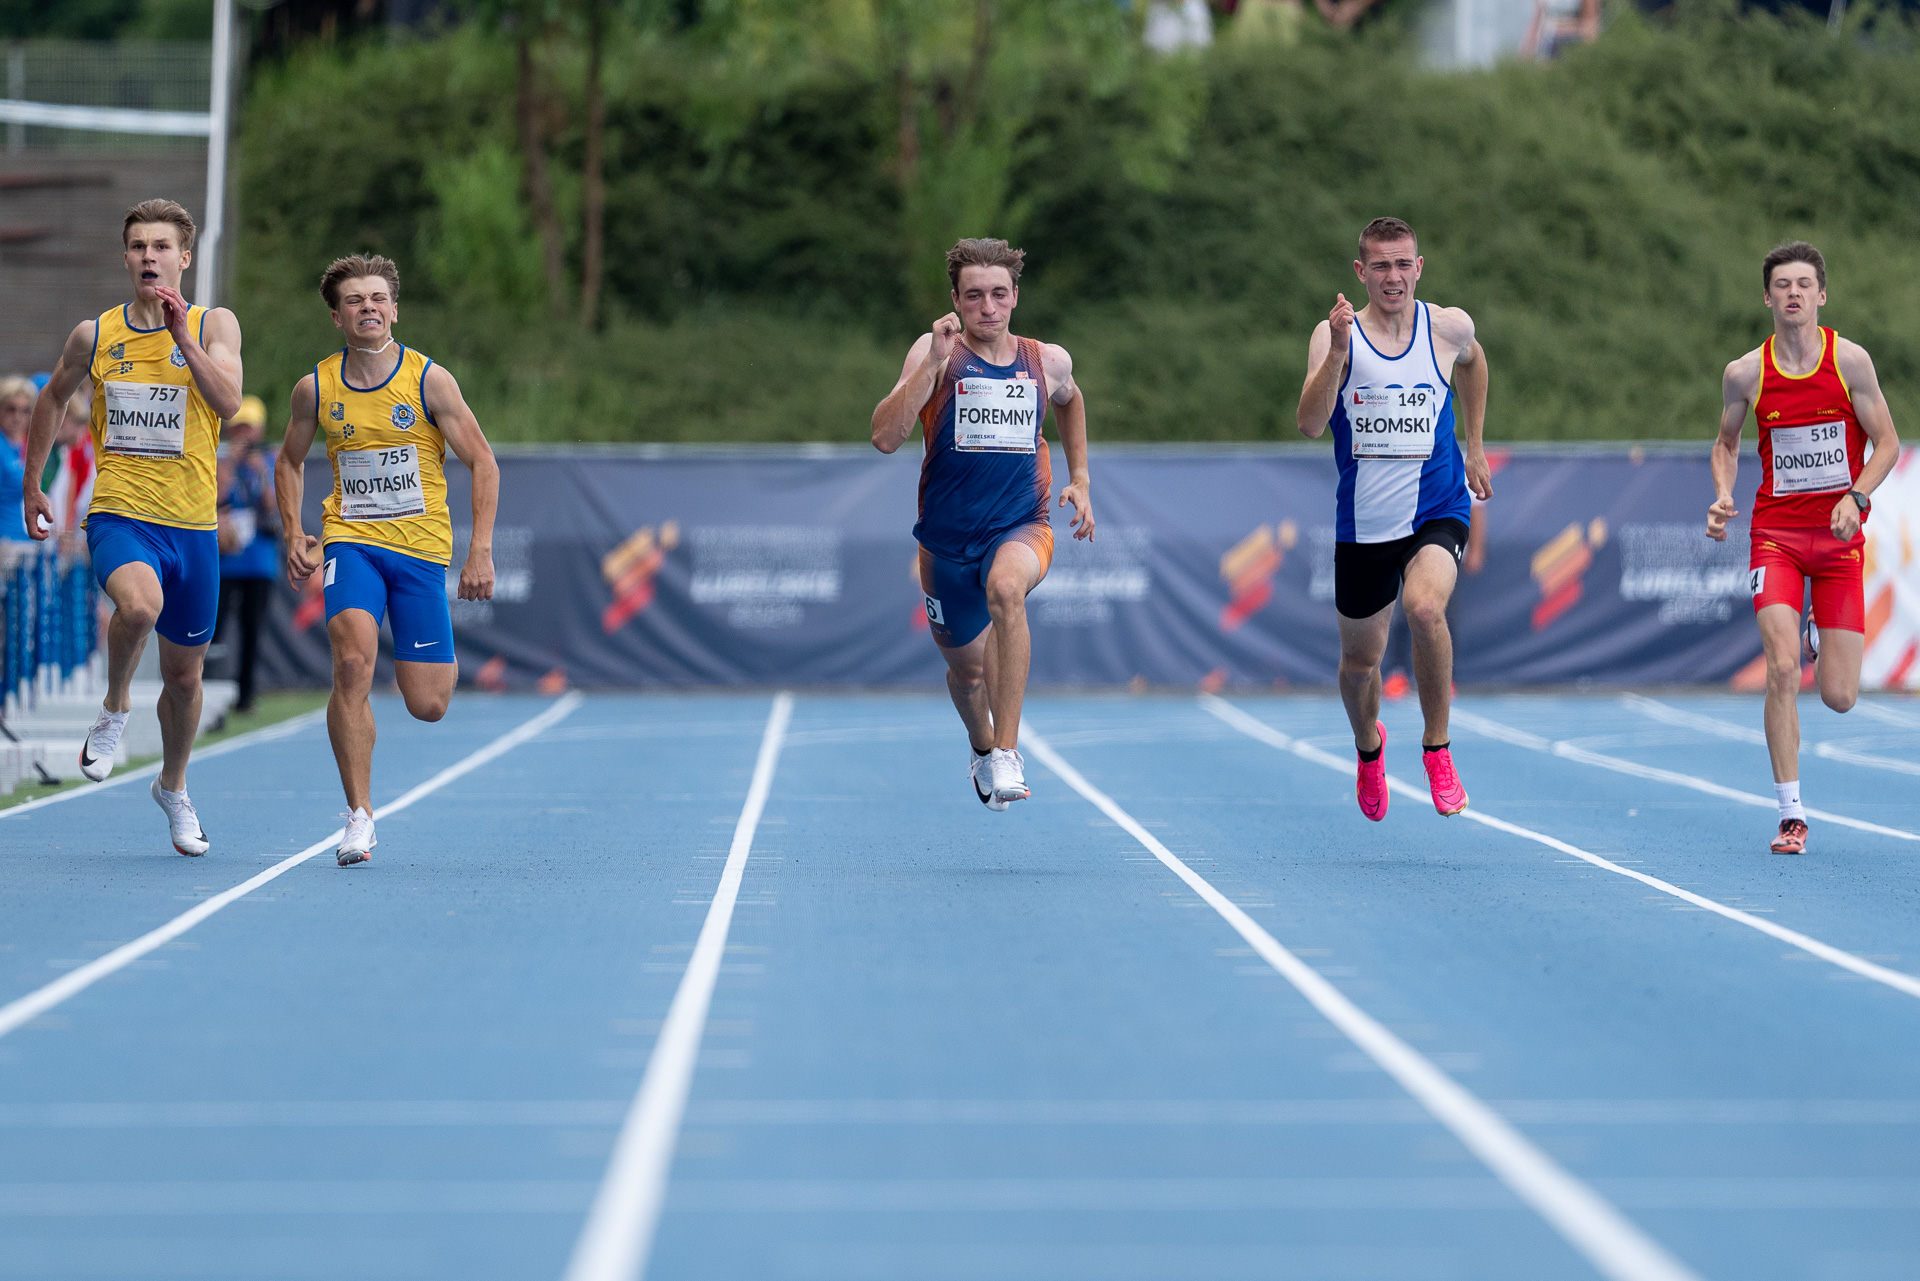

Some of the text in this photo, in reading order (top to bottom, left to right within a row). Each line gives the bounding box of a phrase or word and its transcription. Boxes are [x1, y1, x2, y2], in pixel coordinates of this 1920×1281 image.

[149, 387, 179, 402] 757
[1005, 384, 1025, 398] 22
[1398, 393, 1426, 407] 149
[108, 409, 181, 430] ZIMNIAK
[959, 407, 1034, 426] FOREMNY
[1355, 417, 1430, 433] SŁOMSKI
[1811, 425, 1838, 442] 518
[378, 448, 409, 466] 755
[1774, 448, 1844, 470] DONDZIŁO
[342, 472, 417, 495] WOJTASIK
[1750, 570, 1759, 593] 4
[925, 596, 938, 620] 6
